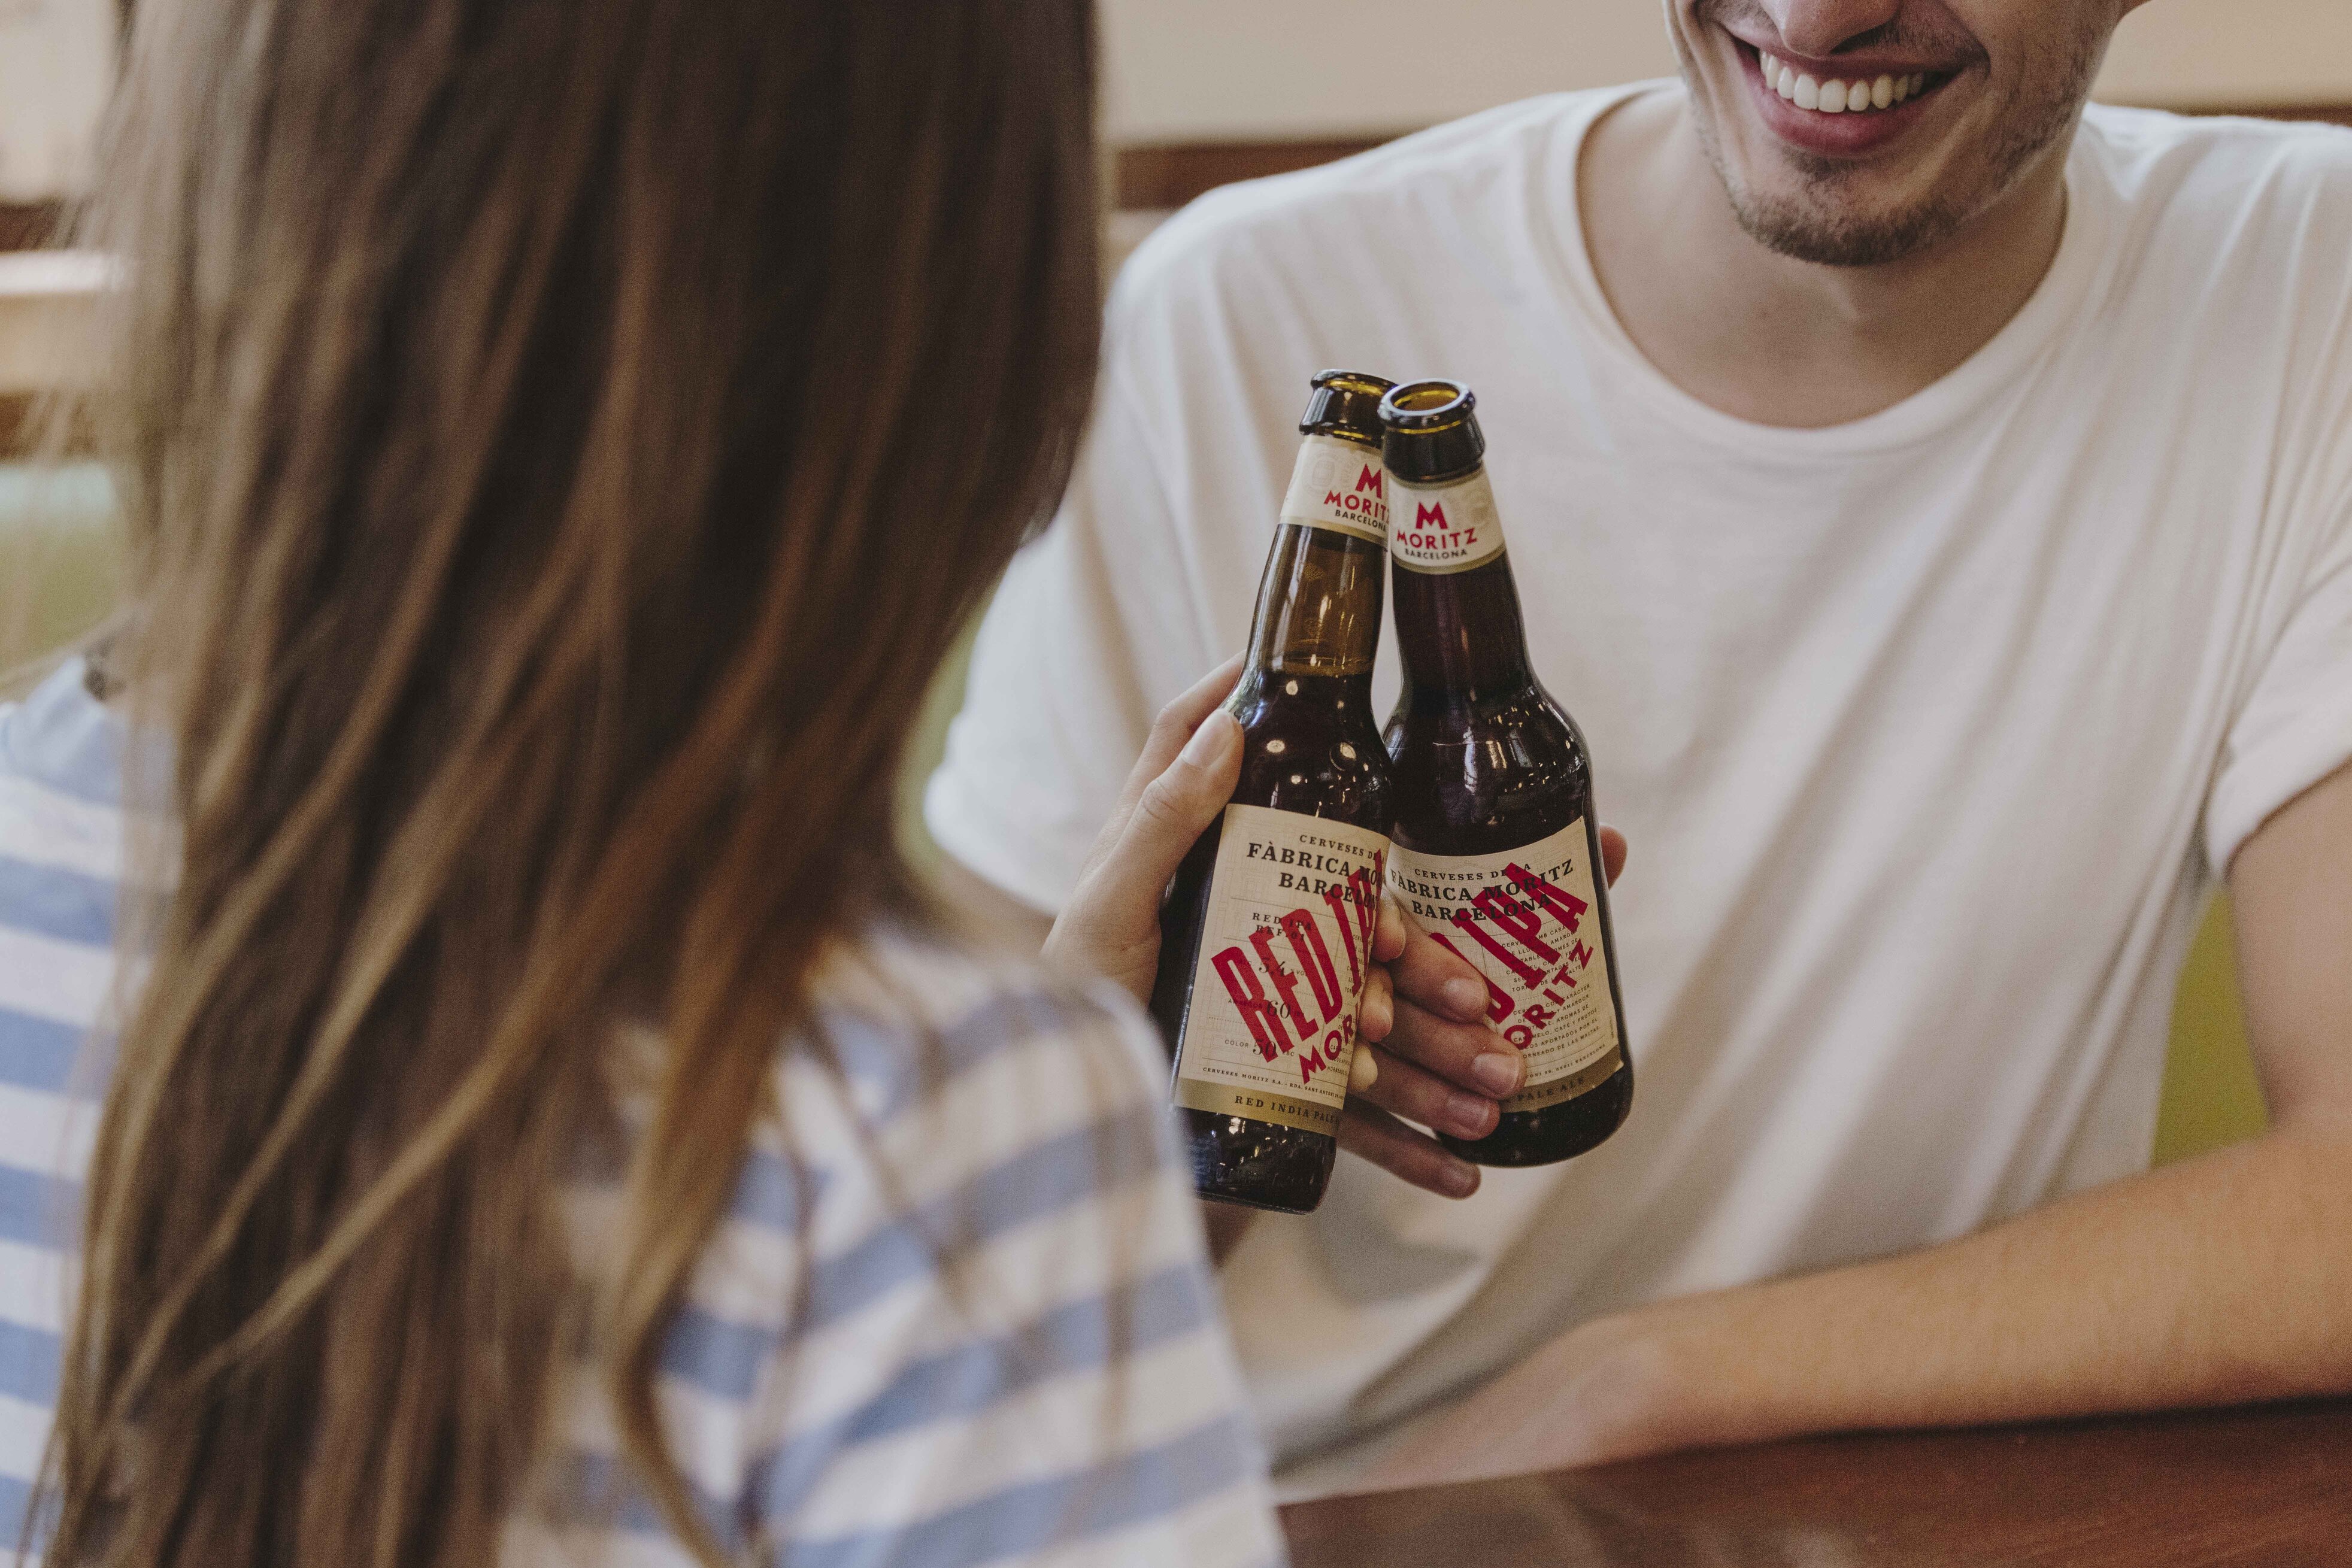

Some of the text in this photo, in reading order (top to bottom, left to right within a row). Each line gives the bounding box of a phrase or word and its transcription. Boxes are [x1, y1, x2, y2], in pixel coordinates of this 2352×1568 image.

[1355, 463, 1382, 499] M
[1416, 501, 1448, 529] M
[1396, 527, 1478, 550] MORITZ
[1404, 549, 1467, 559] BARCELONA
[1299, 835, 1364, 857] CERVESES
[1246, 841, 1350, 877] FÀBRICA
[1390, 858, 1574, 902] FÀBRICA MORITZ
[1414, 868, 1484, 881] CERVESES
[1252, 912, 1281, 924] RED
[1411, 892, 1553, 922] BARCELONA
[1450, 862, 1589, 990] IPA
[1211, 908, 1342, 1063] RED
[1504, 938, 1594, 1051] ORITZ
[1266, 999, 1291, 1019] 60
[1563, 994, 1589, 1011] AMARGOR
[1557, 1008, 1580, 1022] AROMAS
[1578, 1008, 1598, 1022] FRUTOS
[1225, 1039, 1249, 1048] COLOR
[1541, 1029, 1578, 1046] APORTADOS
[1579, 1022, 1590, 1030] POR
[1202, 1067, 1238, 1077] CERVESES
[1242, 1073, 1269, 1082] MORITZ
[1234, 1095, 1265, 1108] RED
[1271, 1102, 1310, 1118] INDIA
